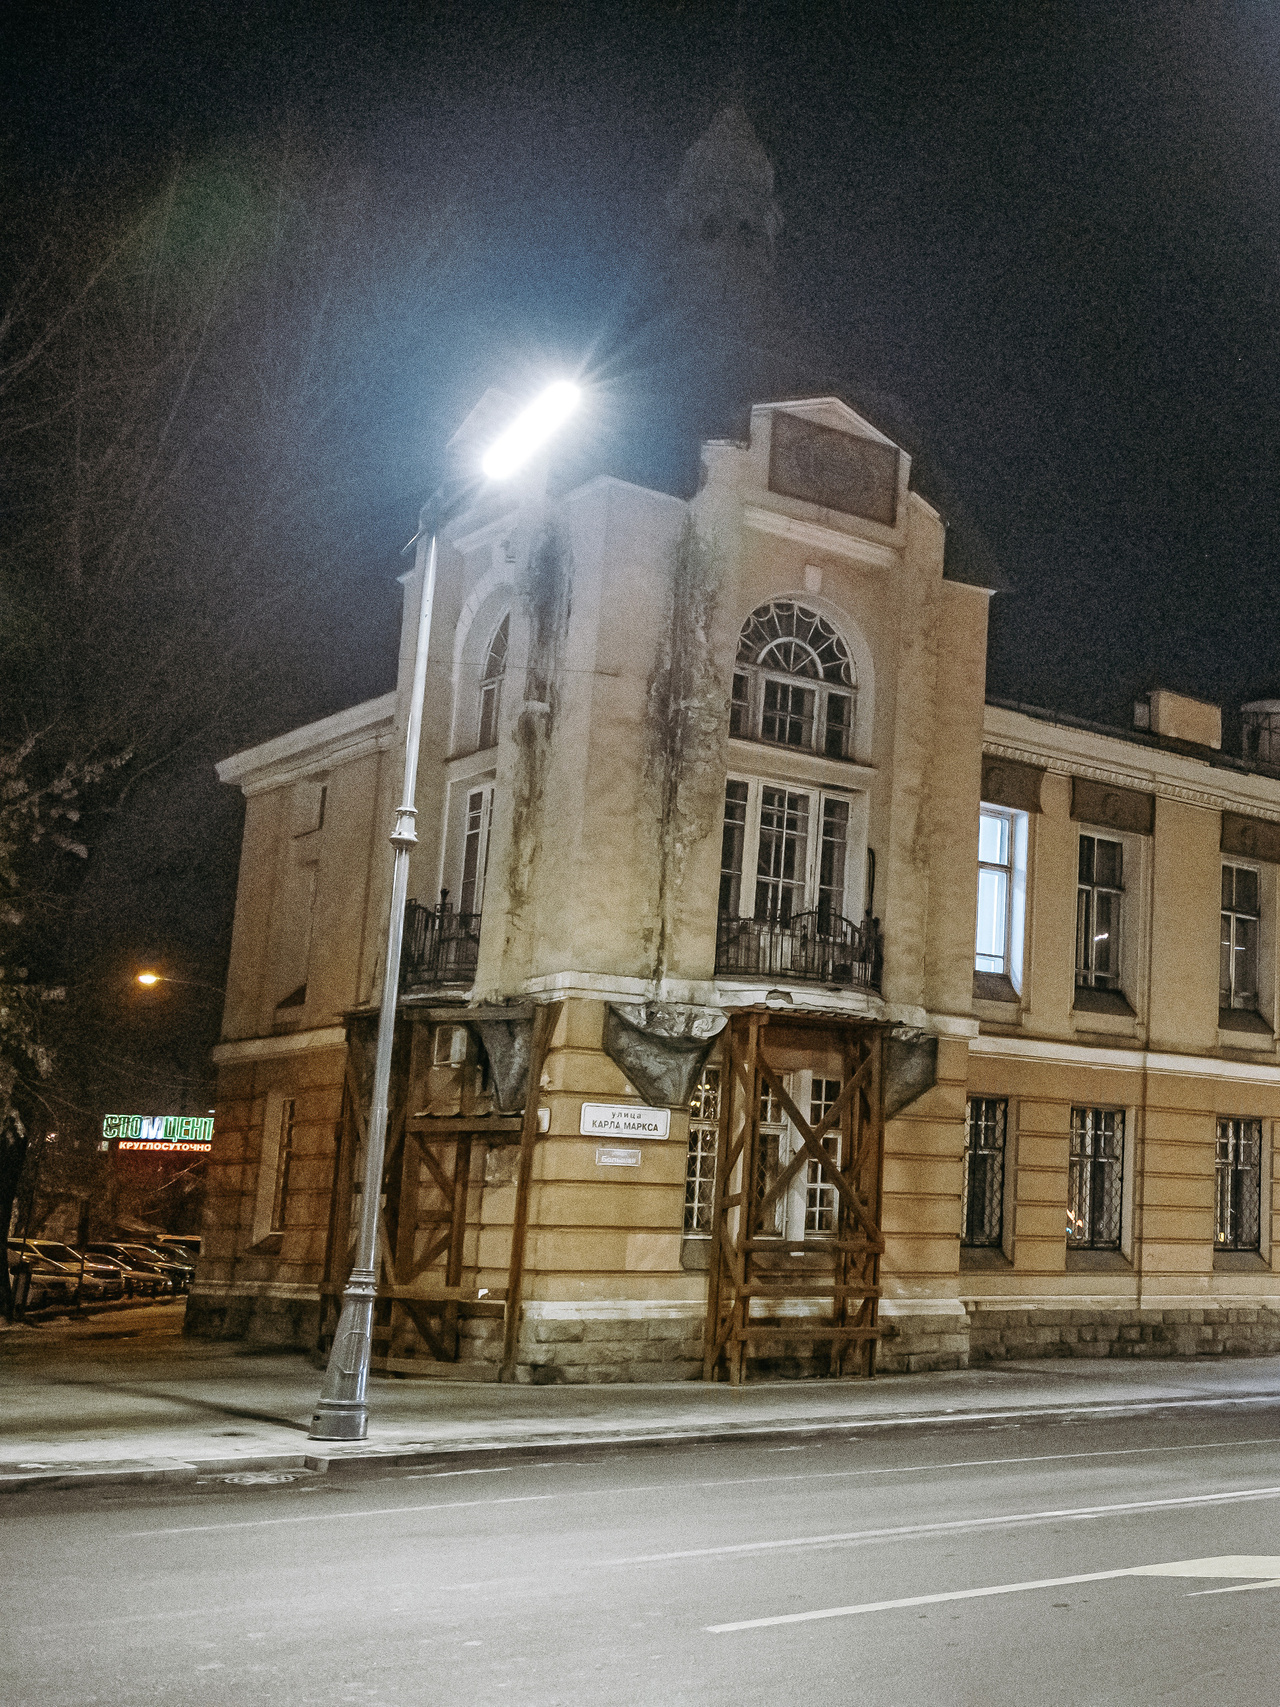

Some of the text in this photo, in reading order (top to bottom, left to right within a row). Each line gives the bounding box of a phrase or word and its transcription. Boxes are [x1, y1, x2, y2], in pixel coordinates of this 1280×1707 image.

[611, 1111, 642, 1120] улица
[592, 1120, 659, 1132] КАРЛА МАРКСА
[119, 1142, 212, 1152] КРУГЛОСУТОЧНО
